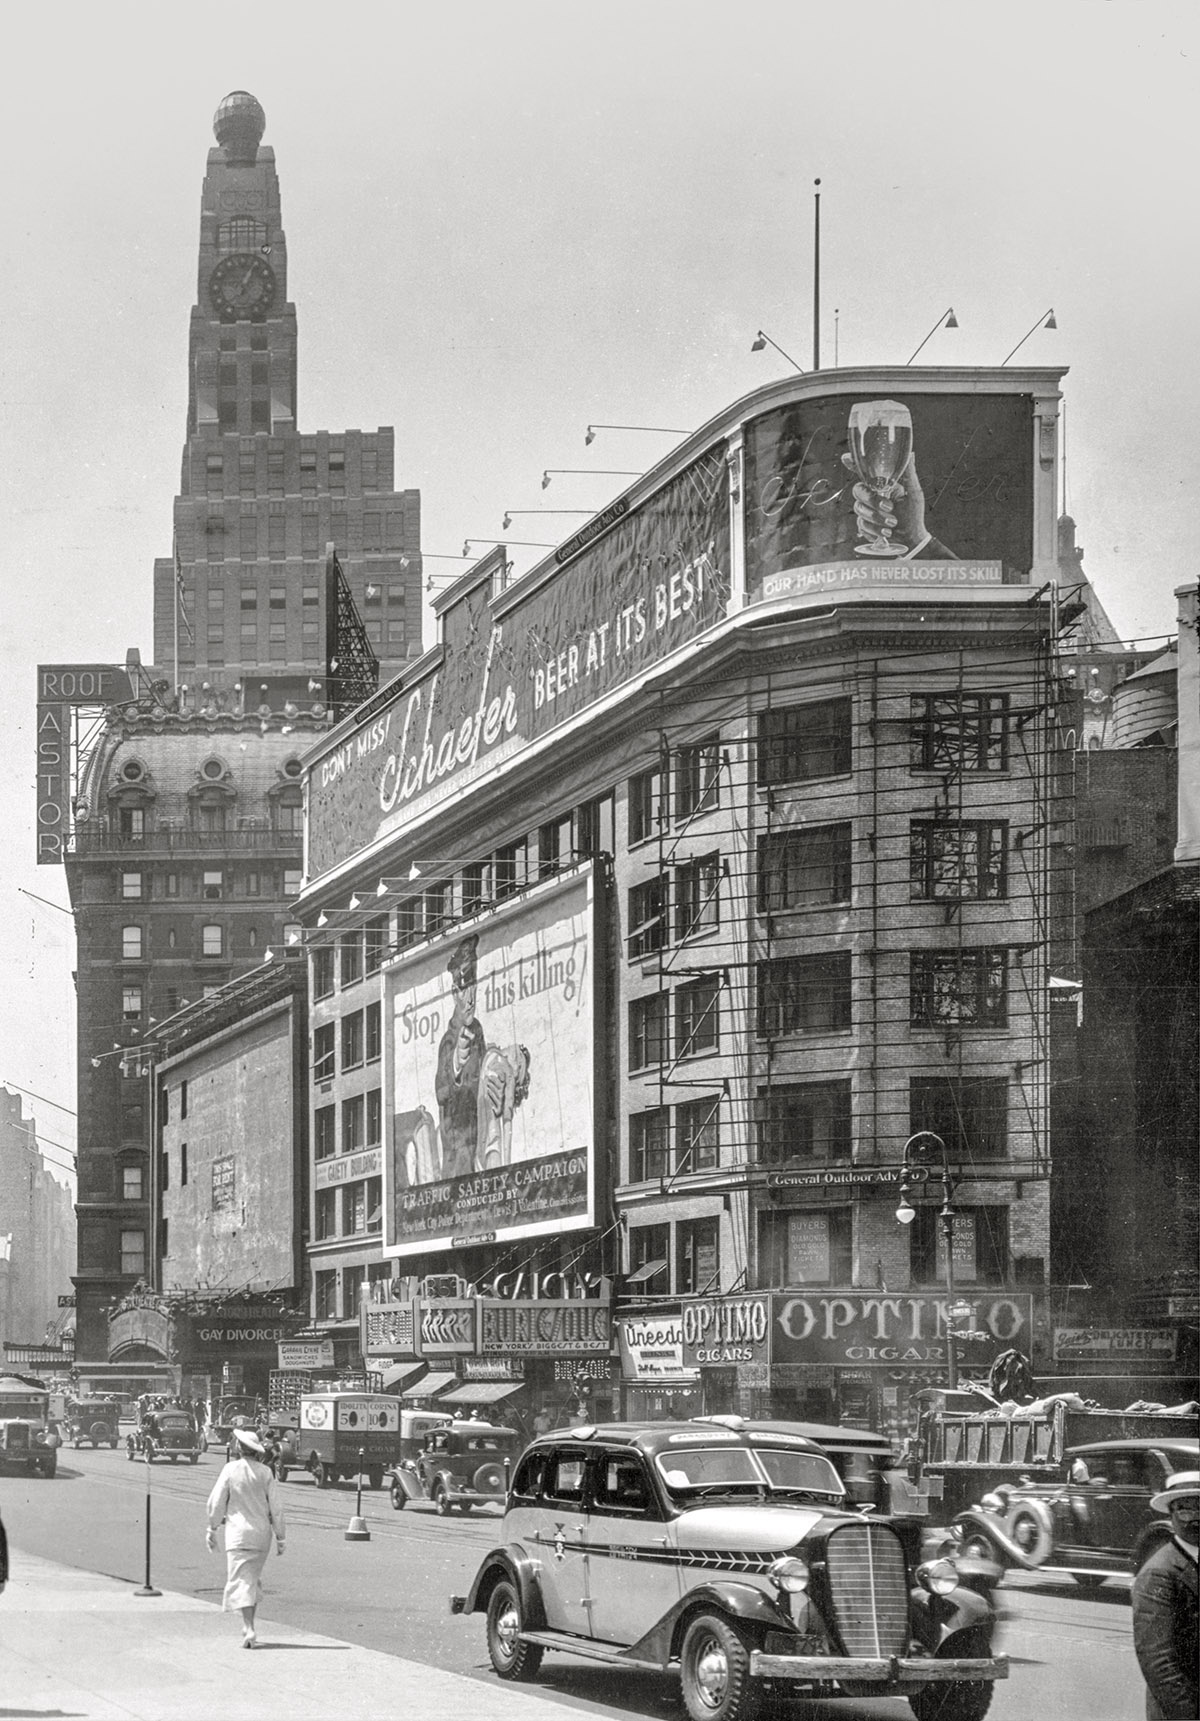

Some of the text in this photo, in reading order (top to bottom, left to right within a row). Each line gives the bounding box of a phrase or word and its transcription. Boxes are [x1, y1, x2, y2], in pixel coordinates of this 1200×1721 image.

[765, 566, 1002, 595] OUR HAND HAS NEVER LOST ITS SKILL
[585, 622, 609, 676] AT
[616, 598, 646, 657] ITS
[43, 672, 113, 697] ROOF
[379, 623, 519, 813] Schaefer
[38, 711, 62, 855] ASTOR
[434, 782, 458, 800] NEVER
[402, 944, 588, 1045] Stop this killing!
[402, 1156, 587, 1209] TRAFFIC SAFETY CAMPAIGN
[774, 1170, 898, 1186] General Outdoor Adv
[456, 1188, 518, 1209] CONDUCTED BY
[427, 1218, 436, 1231] City
[438, 1214, 454, 1227] Police
[791, 1221, 826, 1231] BUYERS
[453, 1236, 468, 1247] General
[791, 1234, 827, 1243] DIAMONDS
[684, 1301, 768, 1346] OPTIMO
[626, 1325, 683, 1347] Uneeda
[1110, 1339, 1153, 1349] LUNCH
[506, 1342, 534, 1350] YORK'S
[537, 1342, 573, 1350] BIGGEST
[696, 1347, 753, 1362] CIGARS
[845, 1347, 965, 1360] CIGARS
